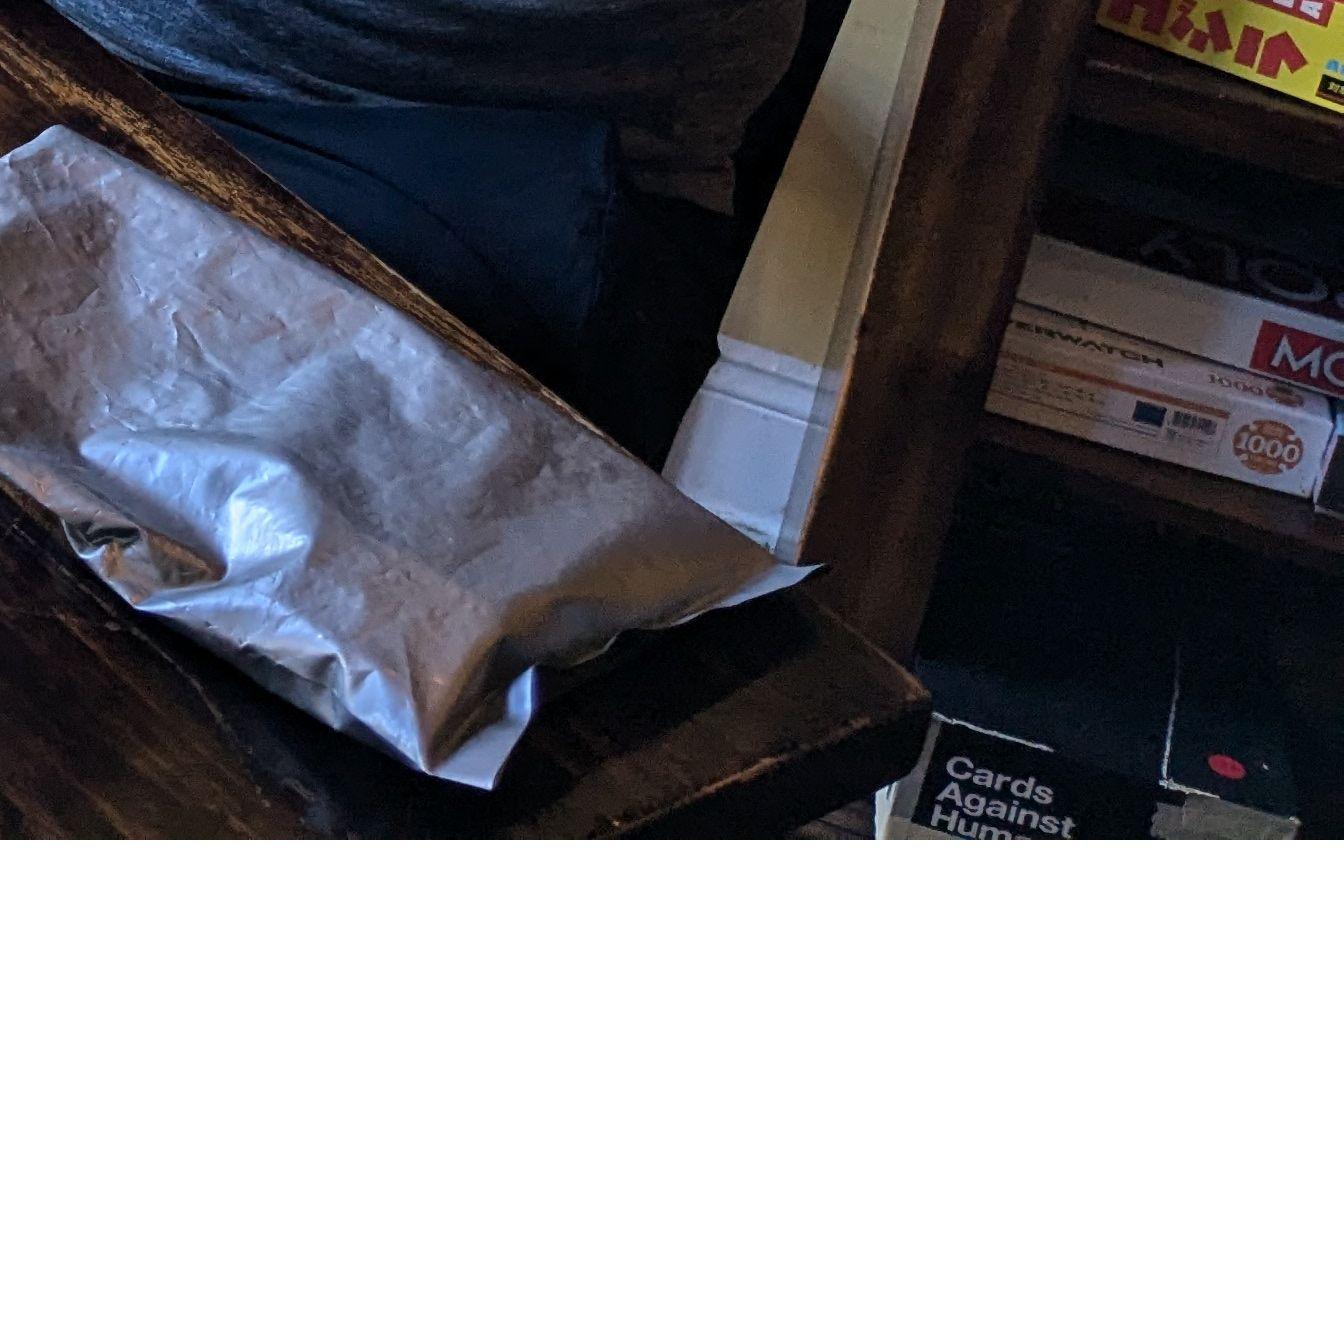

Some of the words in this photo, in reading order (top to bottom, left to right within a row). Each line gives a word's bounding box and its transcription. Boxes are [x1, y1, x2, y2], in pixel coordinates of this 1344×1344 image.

[1238, 430, 1301, 463] 1000
[946, 755, 1055, 806] Cards
[935, 782, 1076, 839] Against
